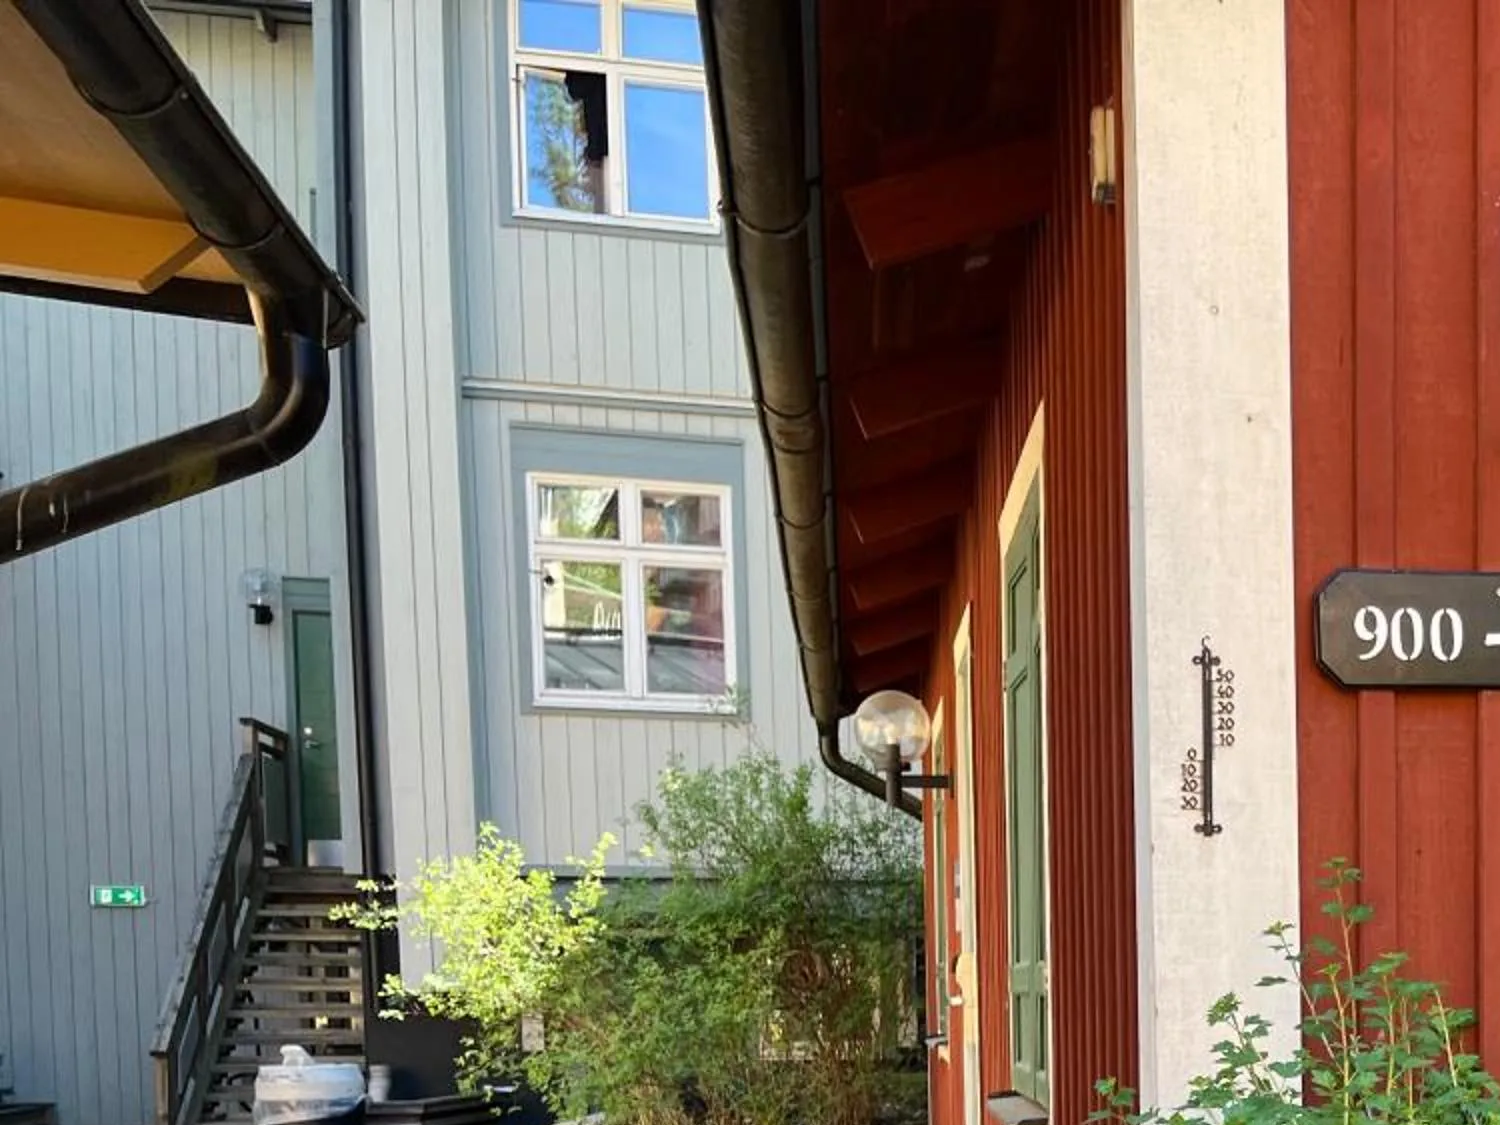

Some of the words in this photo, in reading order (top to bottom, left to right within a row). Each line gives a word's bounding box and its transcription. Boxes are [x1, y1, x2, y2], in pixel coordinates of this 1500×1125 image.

[1353, 605, 1463, 662] 900
[1216, 669, 1235, 683] 50
[1217, 685, 1235, 699] 40
[1217, 701, 1235, 715] 30
[1217, 717, 1235, 731] 20
[1219, 733, 1235, 747] 10
[1187, 747, 1197, 760] 0
[1181, 763, 1197, 776] 10
[1181, 778, 1198, 792] 20
[1180, 796, 1198, 810] 30
